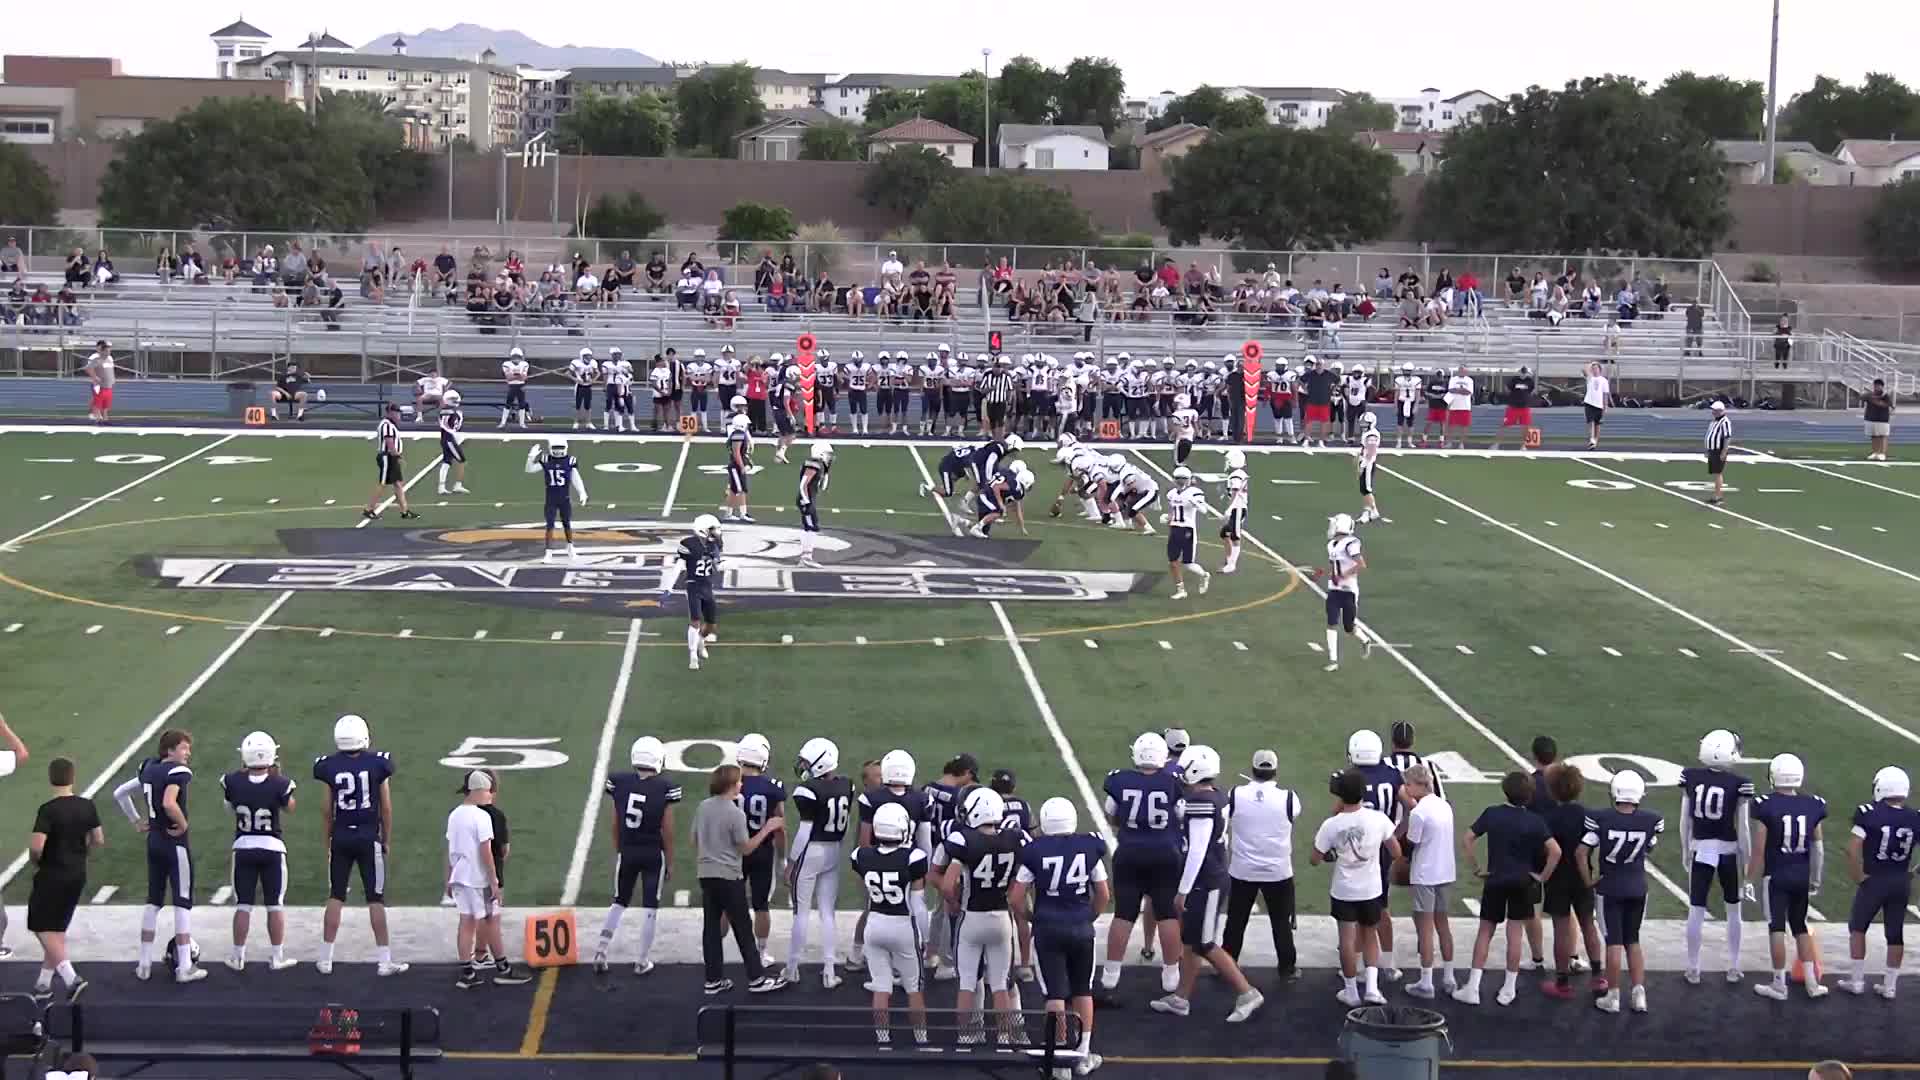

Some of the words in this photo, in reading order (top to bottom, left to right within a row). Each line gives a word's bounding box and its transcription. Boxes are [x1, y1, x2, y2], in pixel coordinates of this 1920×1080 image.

[852, 375, 865, 386] 35
[1274, 381, 1288, 392] 70
[247, 408, 261, 422] 40
[681, 416, 696, 430] 50
[1101, 422, 1116, 435] 40
[548, 469, 566, 487] 15
[1173, 504, 1185, 523] 11
[175, 559, 1115, 600] EAGES
[695, 559, 713, 577] 22
[334, 770, 372, 812] 21
[1694, 785, 1726, 821] 10
[624, 792, 647, 830] 5
[823, 796, 849, 833] 16
[1121, 789, 1170, 830] 76
[1607, 830, 1647, 864] 77
[1780, 815, 1807, 854] 11
[1875, 825, 1914, 862] 13
[864, 871, 904, 905] 65
[972, 852, 1015, 889] 47
[1041, 852, 1089, 897] 74
[534, 918, 571, 957] 50
